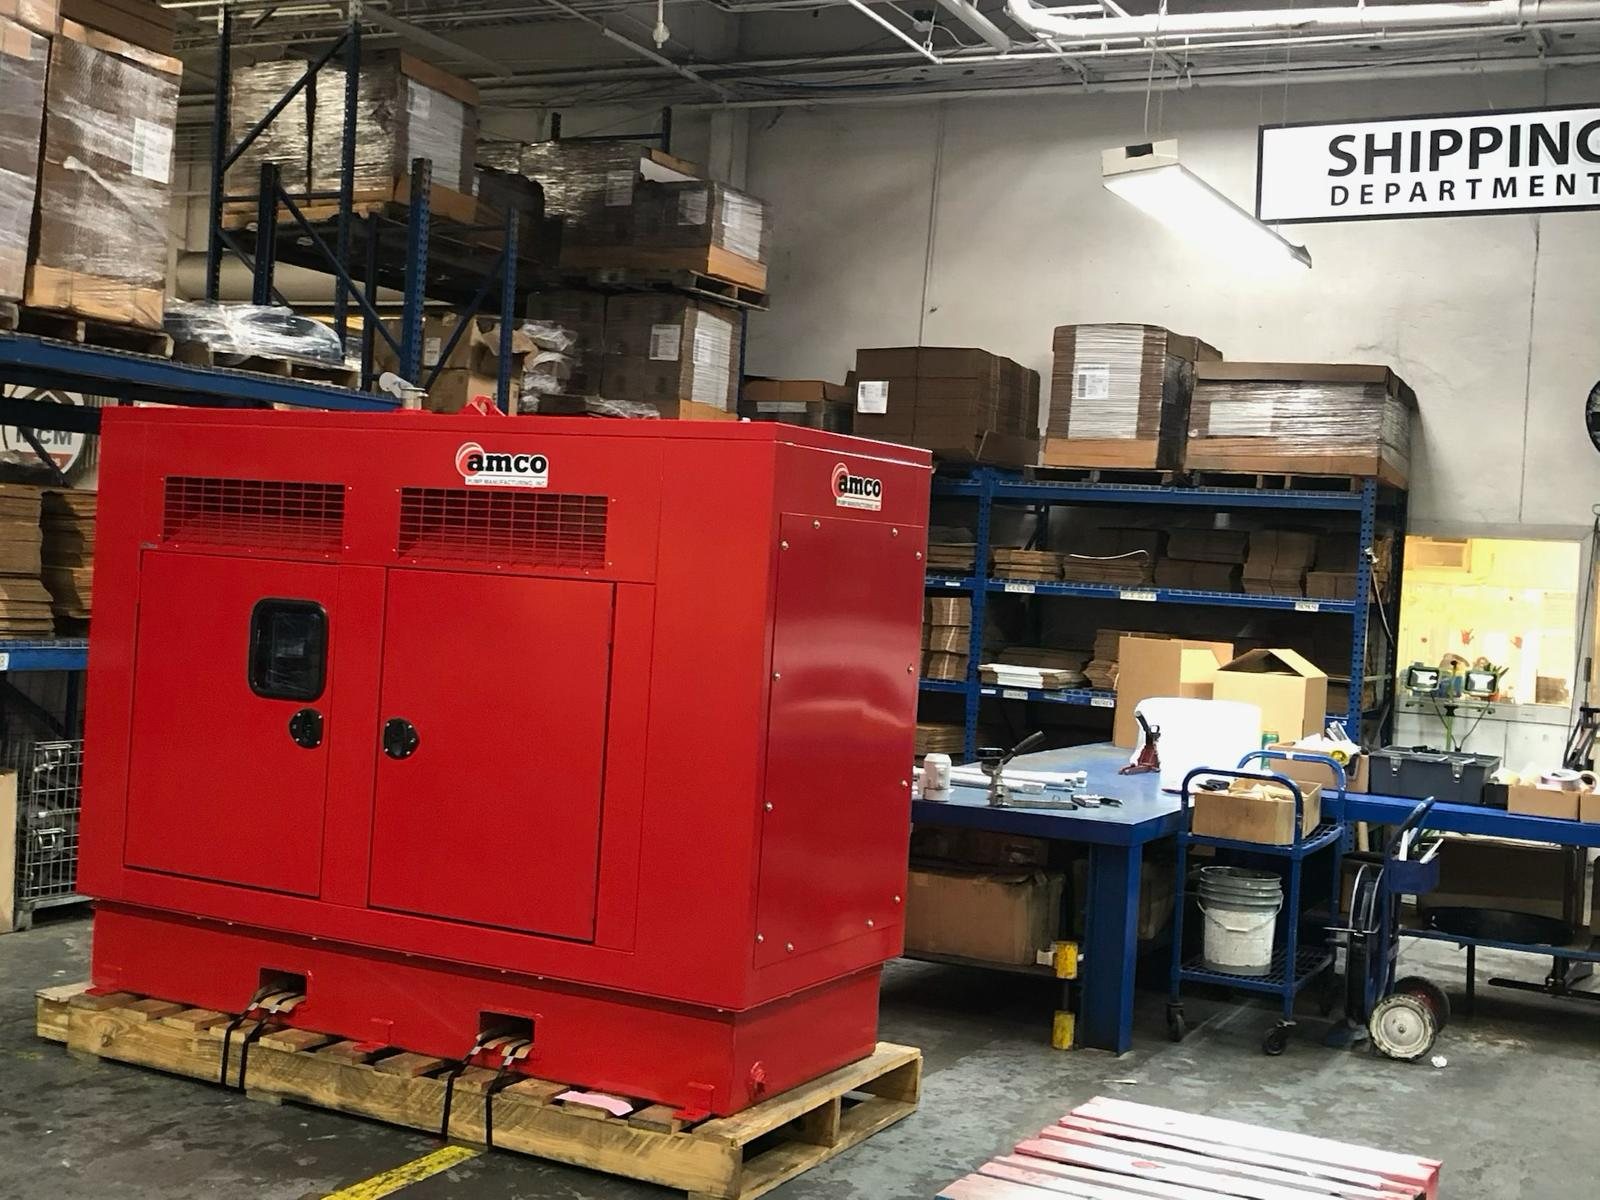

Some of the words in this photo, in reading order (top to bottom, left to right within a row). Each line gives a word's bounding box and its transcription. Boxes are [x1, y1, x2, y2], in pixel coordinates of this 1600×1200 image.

[1331, 173, 1600, 206] DEPARTMENT
[467, 454, 547, 473] amco
[838, 475, 881, 497] amco
